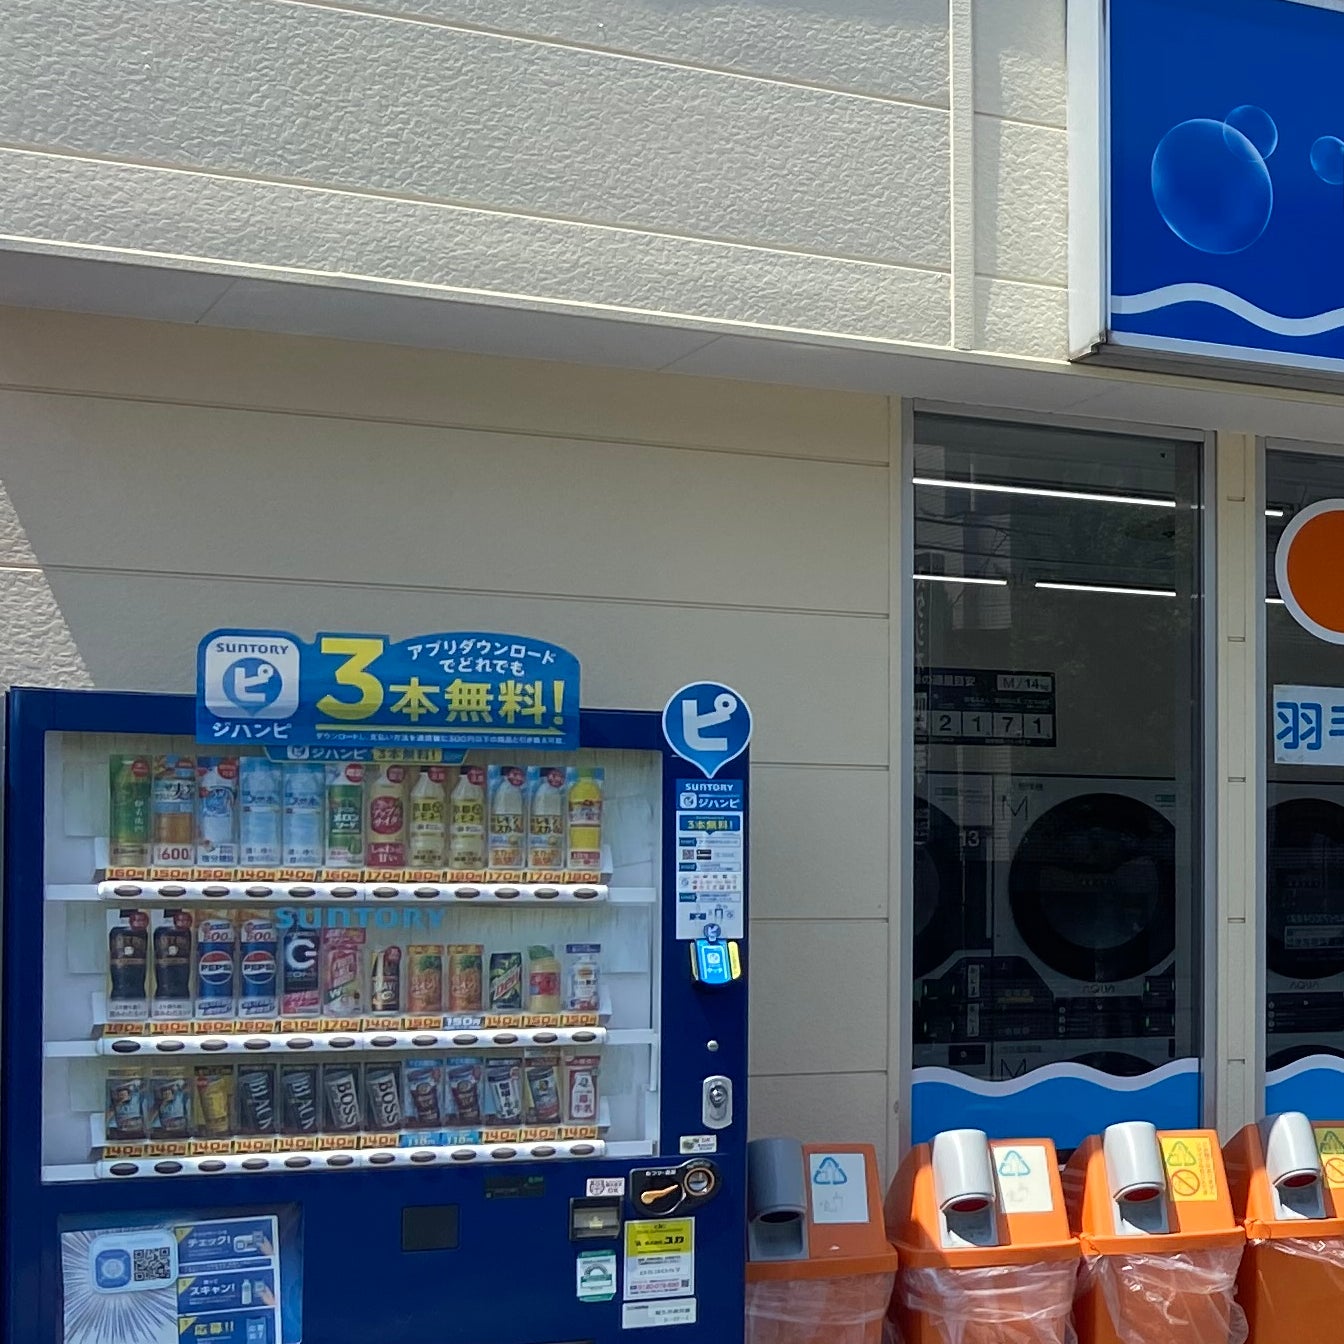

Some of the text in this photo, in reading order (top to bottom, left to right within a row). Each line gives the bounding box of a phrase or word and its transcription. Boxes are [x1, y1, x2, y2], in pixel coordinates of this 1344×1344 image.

[215, 641, 289, 656] SUNTORY
[407, 638, 557, 665] アプリダウンロード
[439, 656, 526, 676] でどれでも
[211, 722, 293, 740] ジハンピ
[685, 782, 734, 792] SUNTORY
[275, 906, 446, 929] SUNTORY
[337, 1082, 359, 1128] BOSS
[377, 1080, 399, 1127] BOSS
